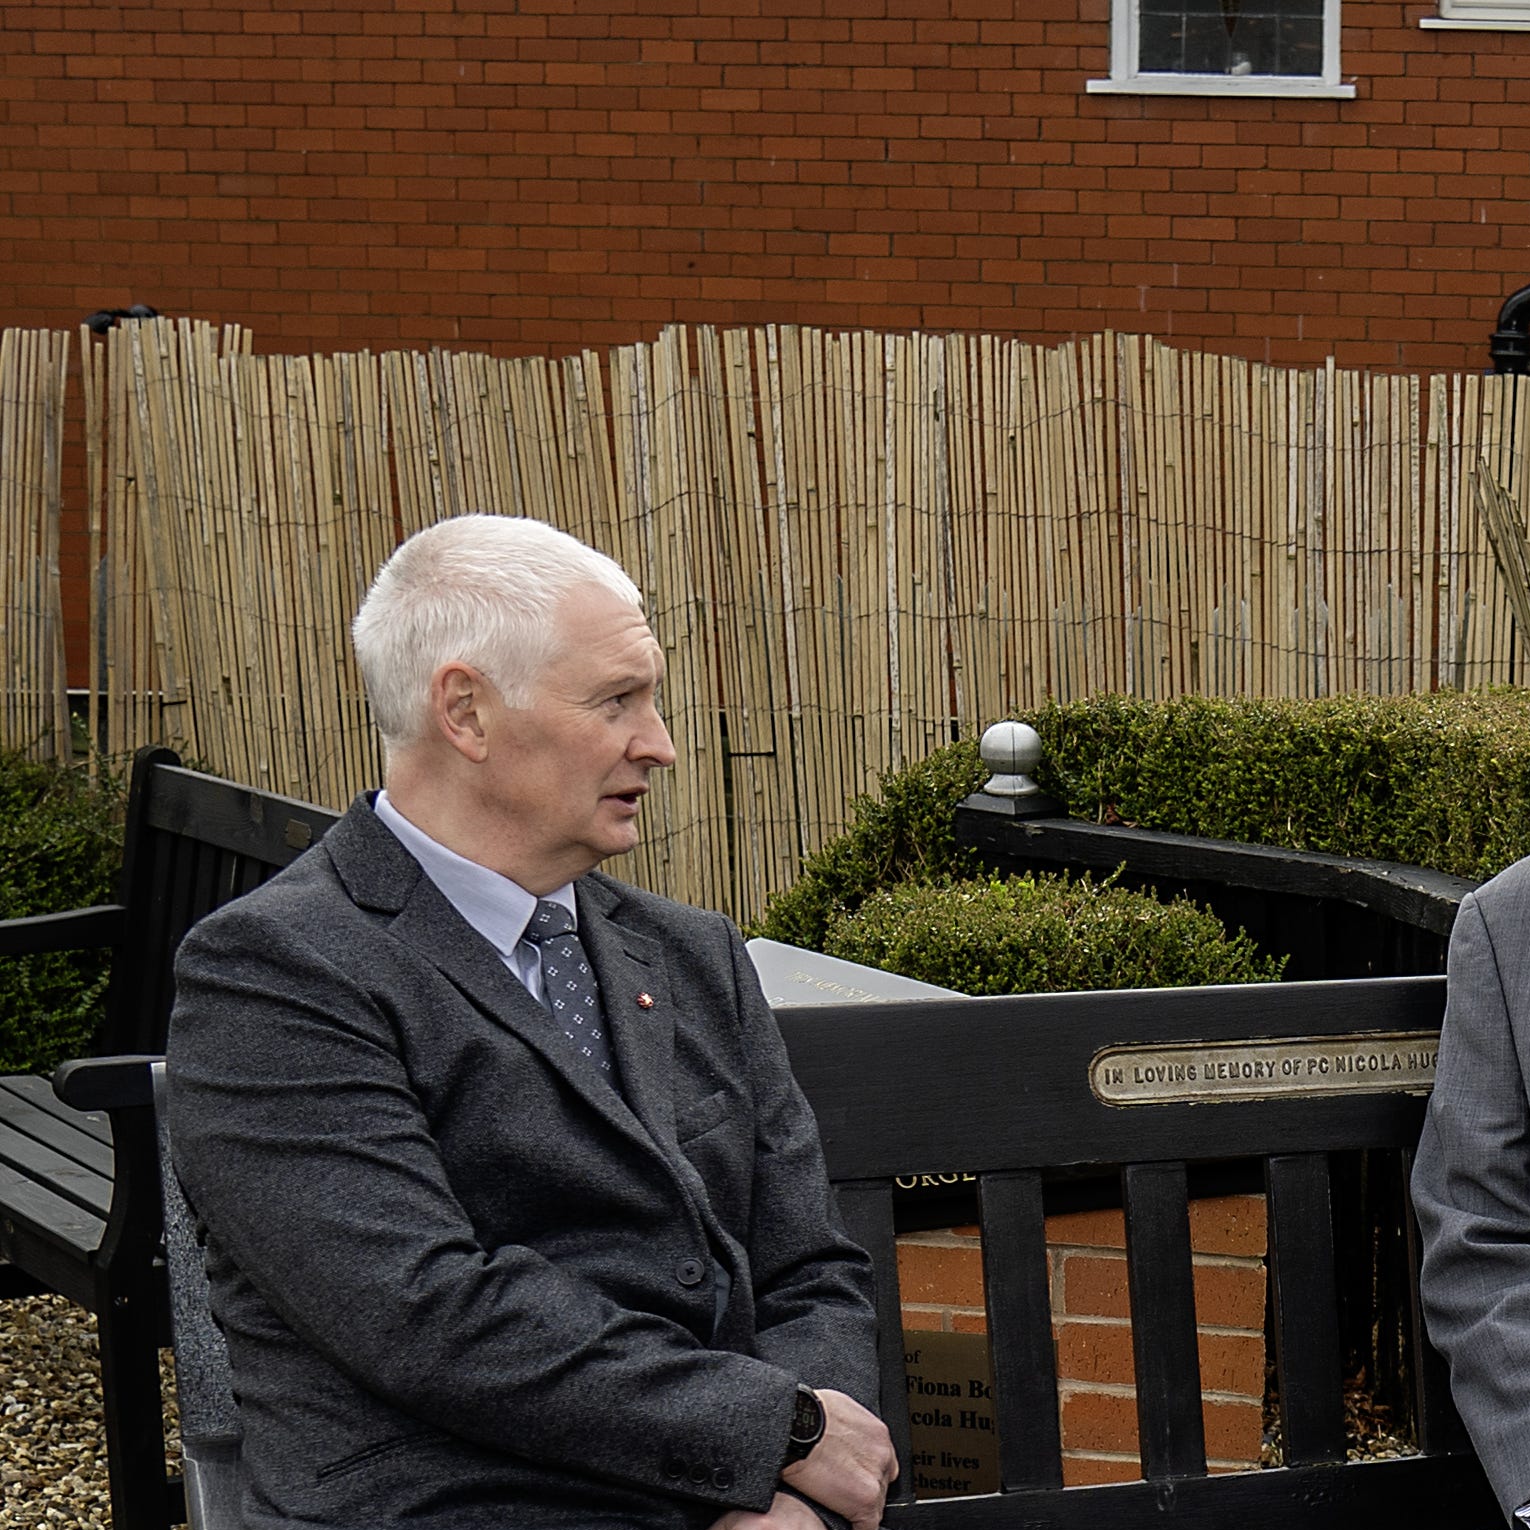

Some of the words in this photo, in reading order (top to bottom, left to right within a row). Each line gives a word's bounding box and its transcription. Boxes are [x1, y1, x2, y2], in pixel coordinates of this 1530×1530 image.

[1104, 1068, 1123, 1085] IN
[1134, 1063, 1197, 1084] LOVING
[1204, 1061, 1275, 1081] MEMORY
[1281, 1059, 1300, 1077] OF
[1307, 1056, 1330, 1075] PC
[1335, 1053, 1402, 1074] NICOLA
[941, 1452, 980, 1470] lives
